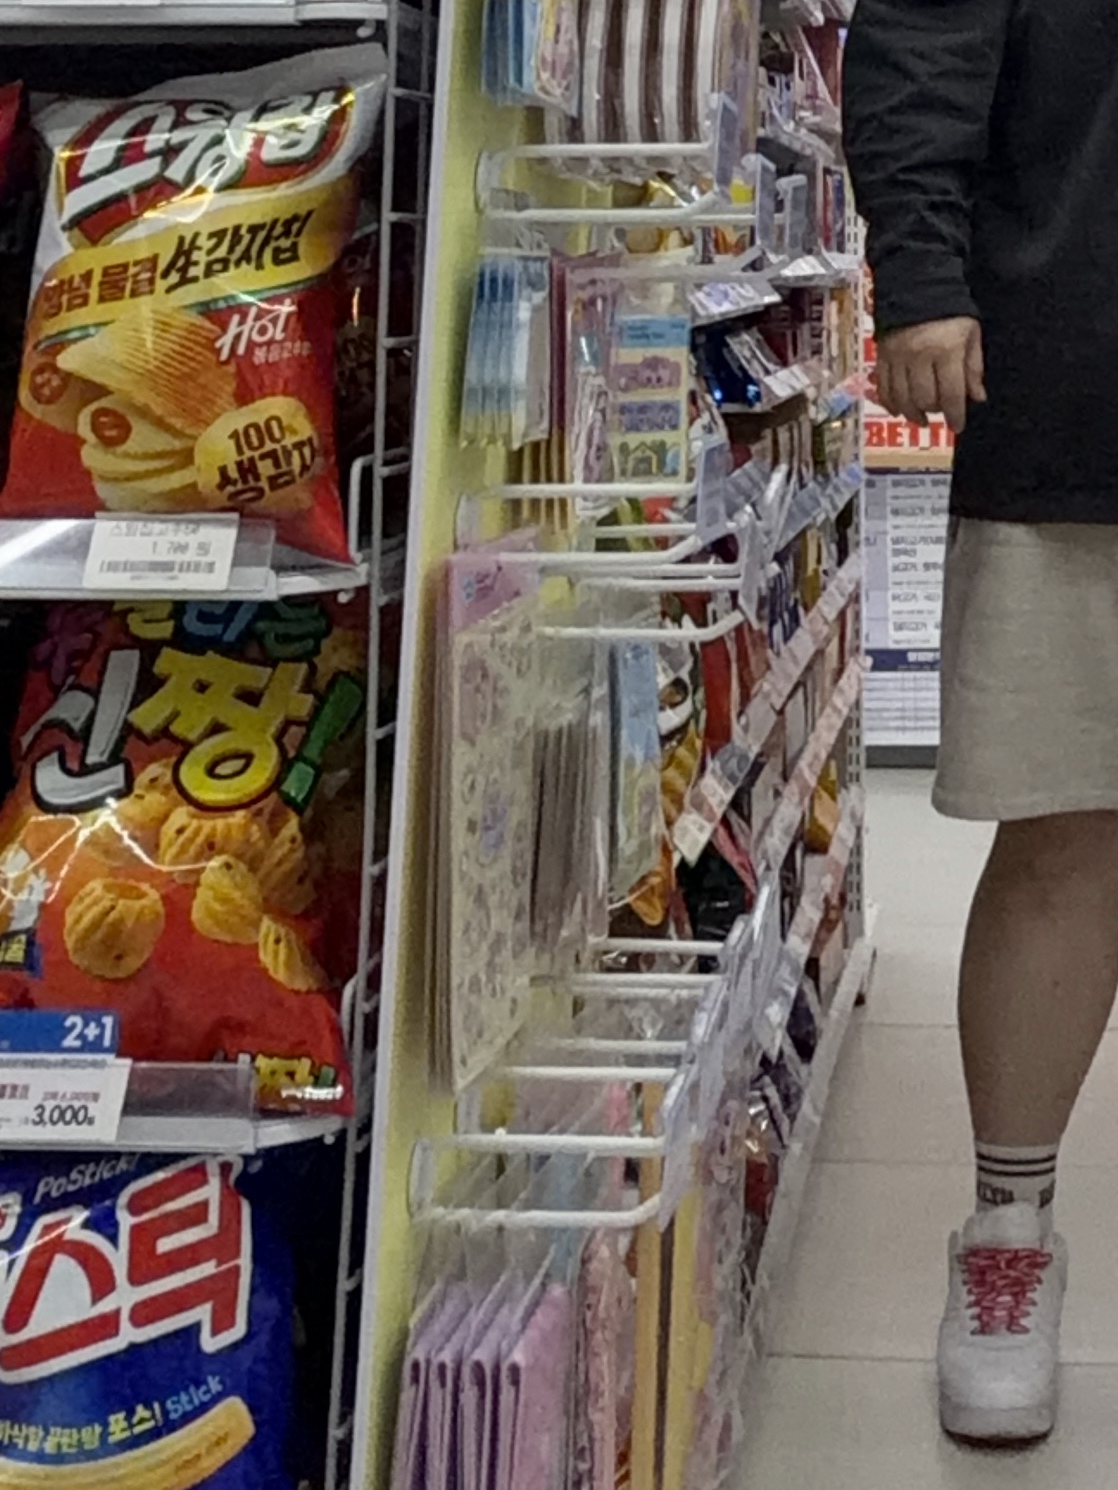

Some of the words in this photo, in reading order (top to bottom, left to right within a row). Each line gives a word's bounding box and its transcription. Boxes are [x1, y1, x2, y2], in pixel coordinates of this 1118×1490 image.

[62, 90, 336, 232] 스윙칩
[97, 253, 160, 306] 물결
[214, 297, 297, 361] Hot
[217, 436, 315, 503] 생감자
[62, 1014, 114, 1048] 2+1
[0, 1158, 250, 1382] 스틱
[165, 1374, 223, 1420] Stick
